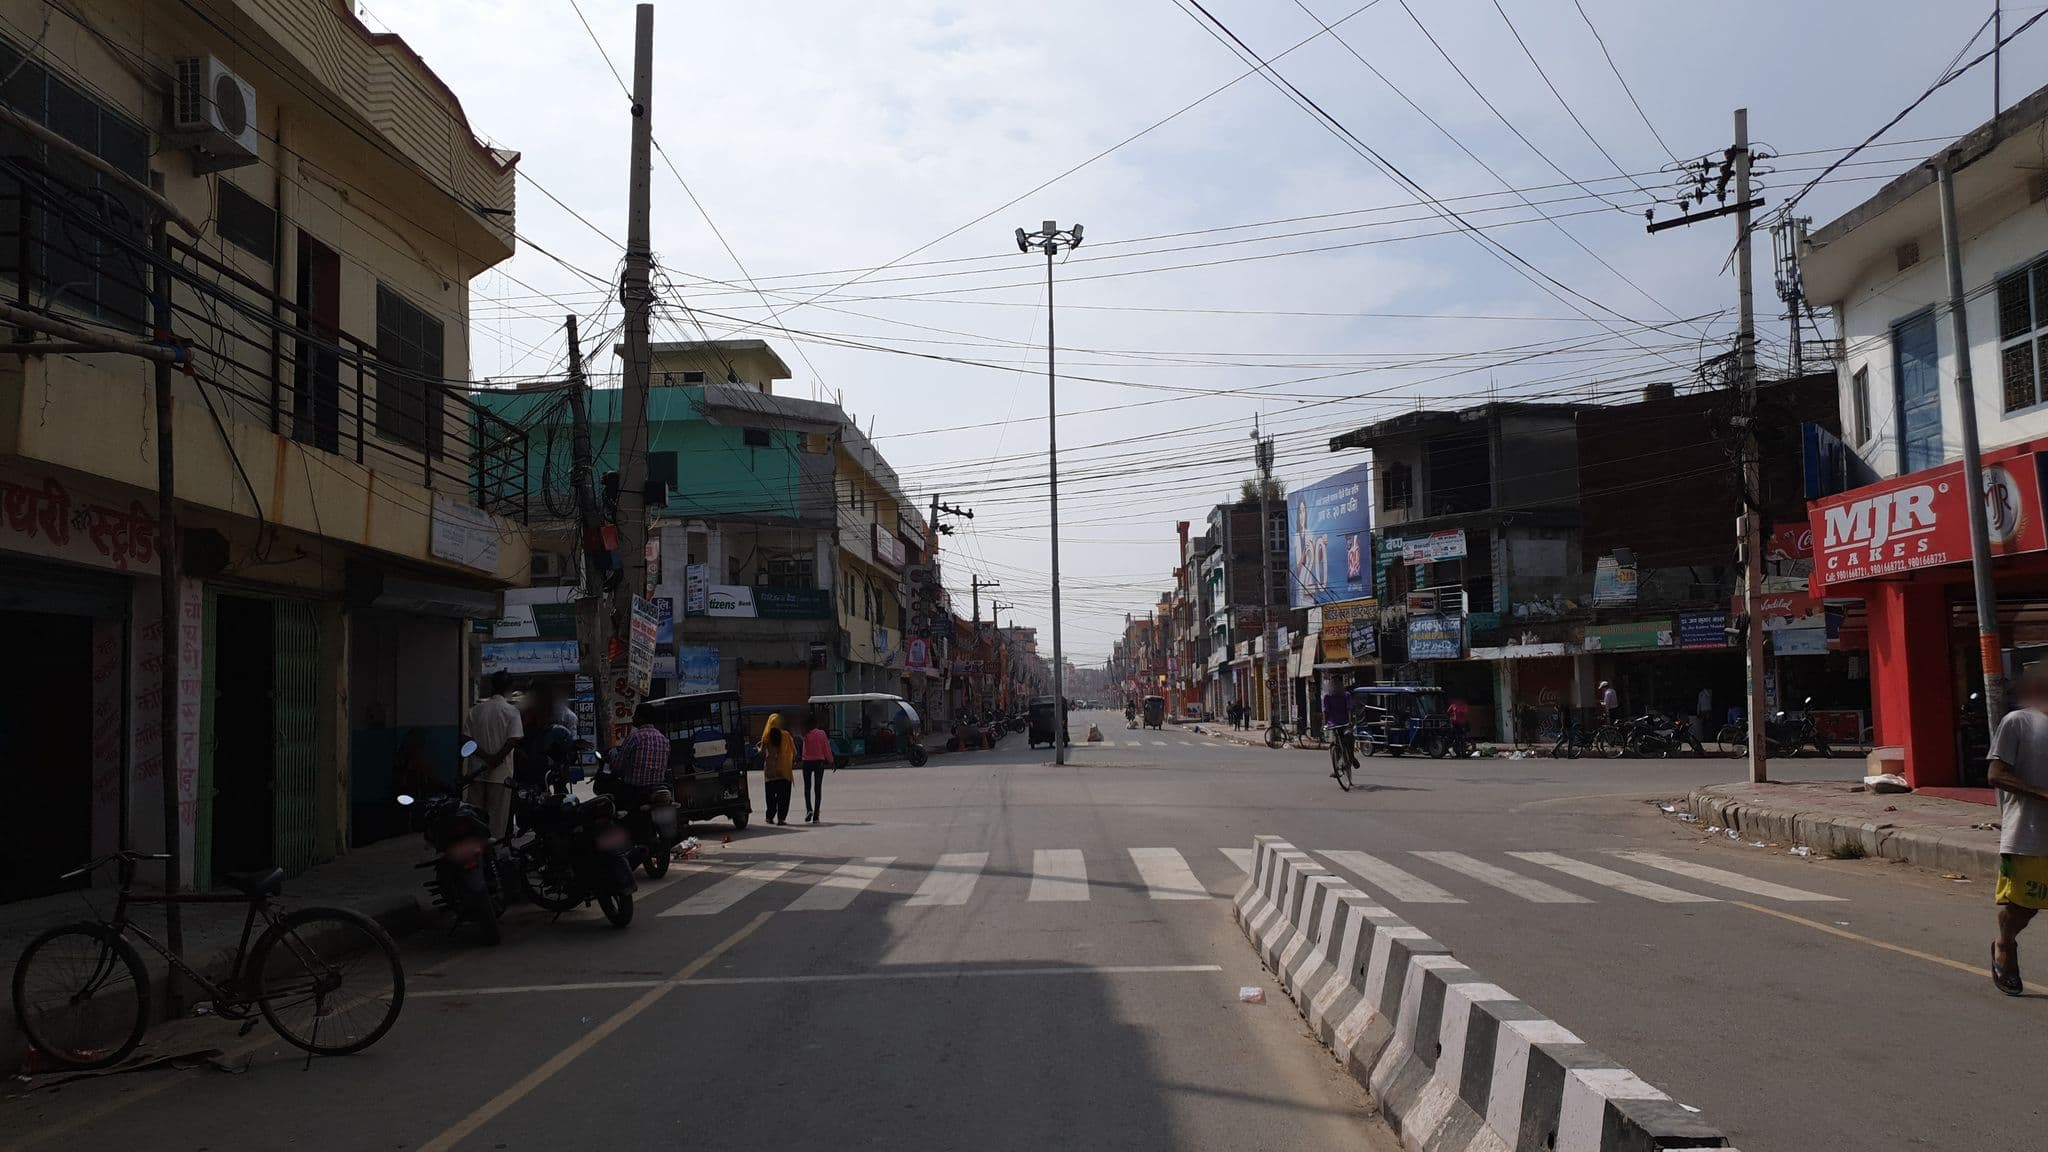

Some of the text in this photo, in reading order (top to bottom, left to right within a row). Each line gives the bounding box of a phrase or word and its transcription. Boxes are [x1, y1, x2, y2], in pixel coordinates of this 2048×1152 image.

[1824, 485, 1936, 548] MJR
[1828, 538, 1928, 570] CAKES
[709, 598, 736, 610] tizens
[1760, 597, 1793, 612] Vadilal
